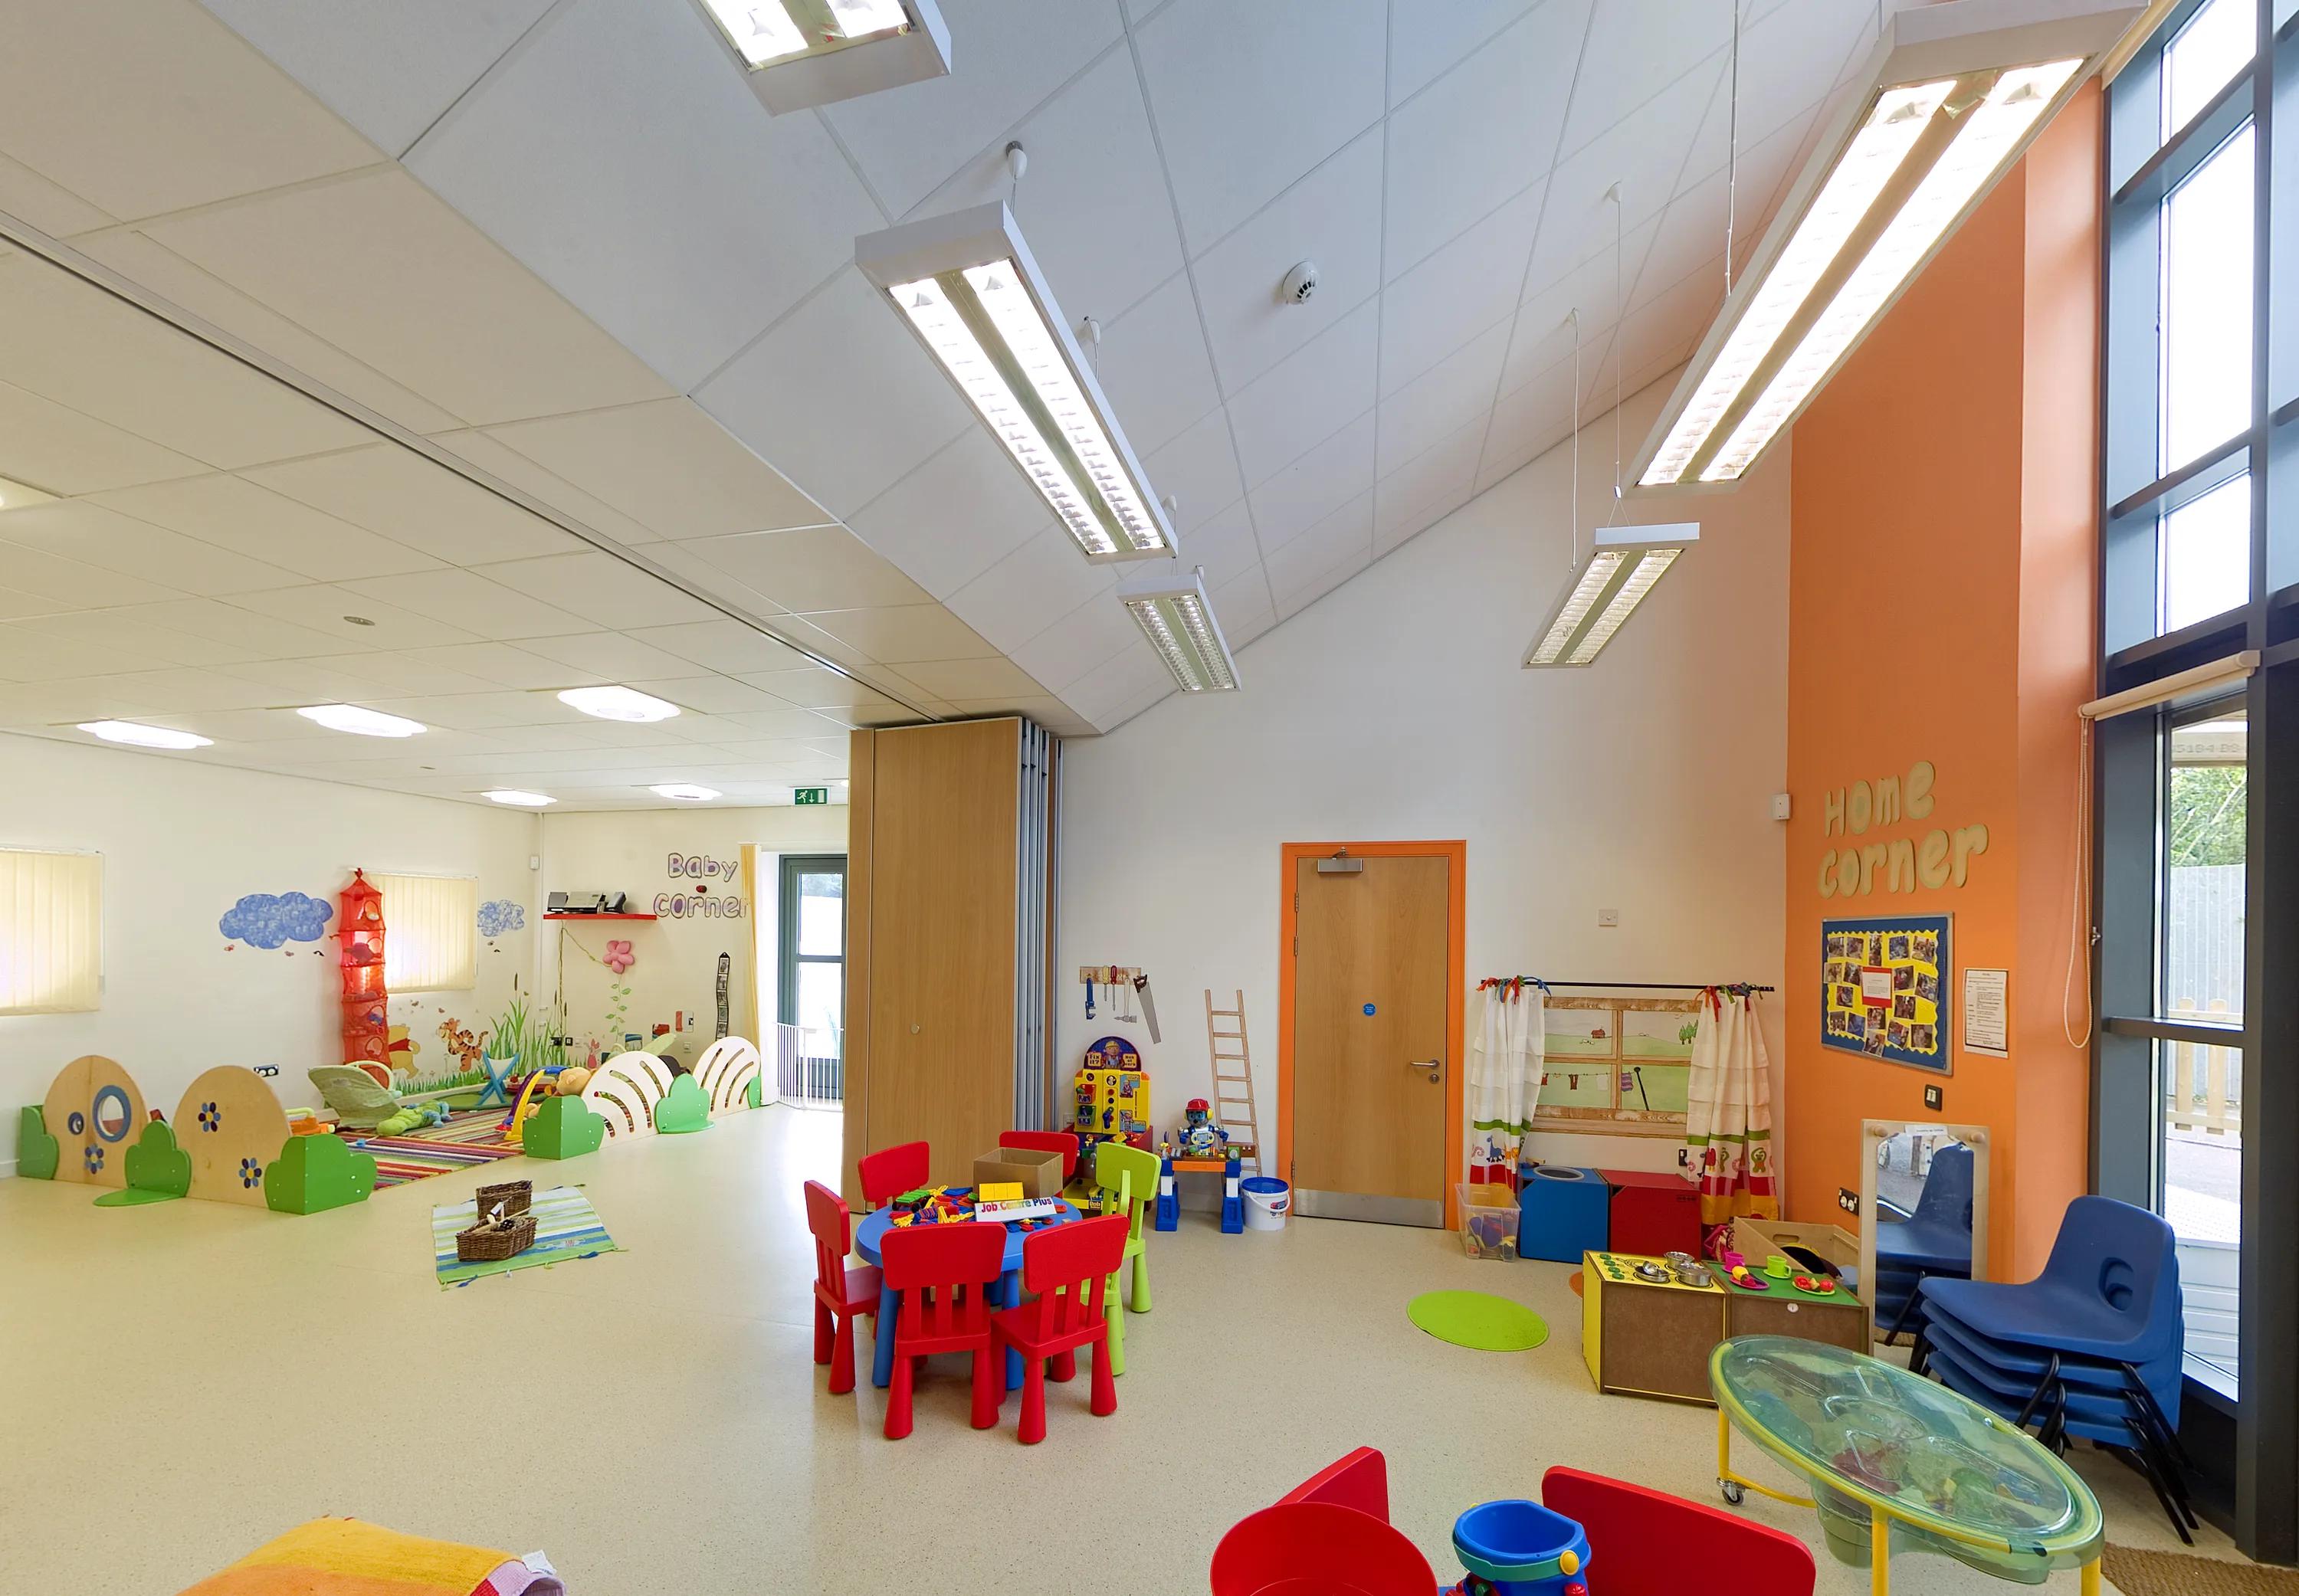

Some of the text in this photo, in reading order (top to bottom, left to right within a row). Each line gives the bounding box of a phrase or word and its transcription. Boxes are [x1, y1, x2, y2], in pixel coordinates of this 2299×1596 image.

[667, 852, 738, 883] Baby
[1817, 823, 1989, 900] corner
[654, 893, 749, 919] corner
[981, 1202, 998, 1213] Job
[1033, 1197, 1052, 1207] Plus
